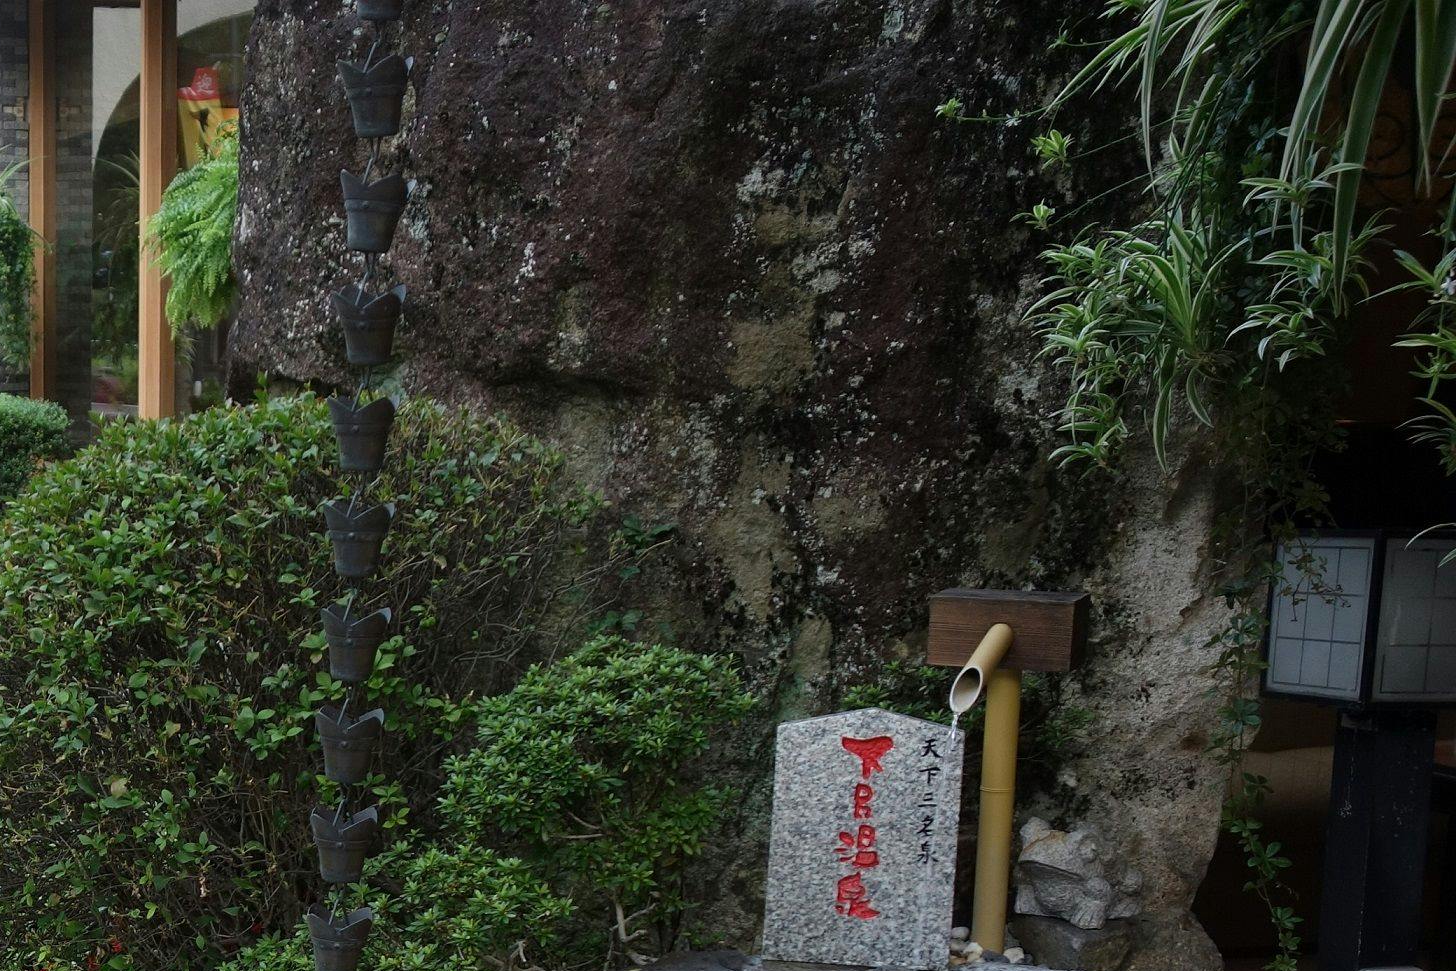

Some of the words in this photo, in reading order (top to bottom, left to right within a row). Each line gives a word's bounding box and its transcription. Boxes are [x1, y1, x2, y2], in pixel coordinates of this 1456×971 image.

[834, 735, 895, 921] 下呂温泉
[916, 738, 942, 865] 天下三名泉
